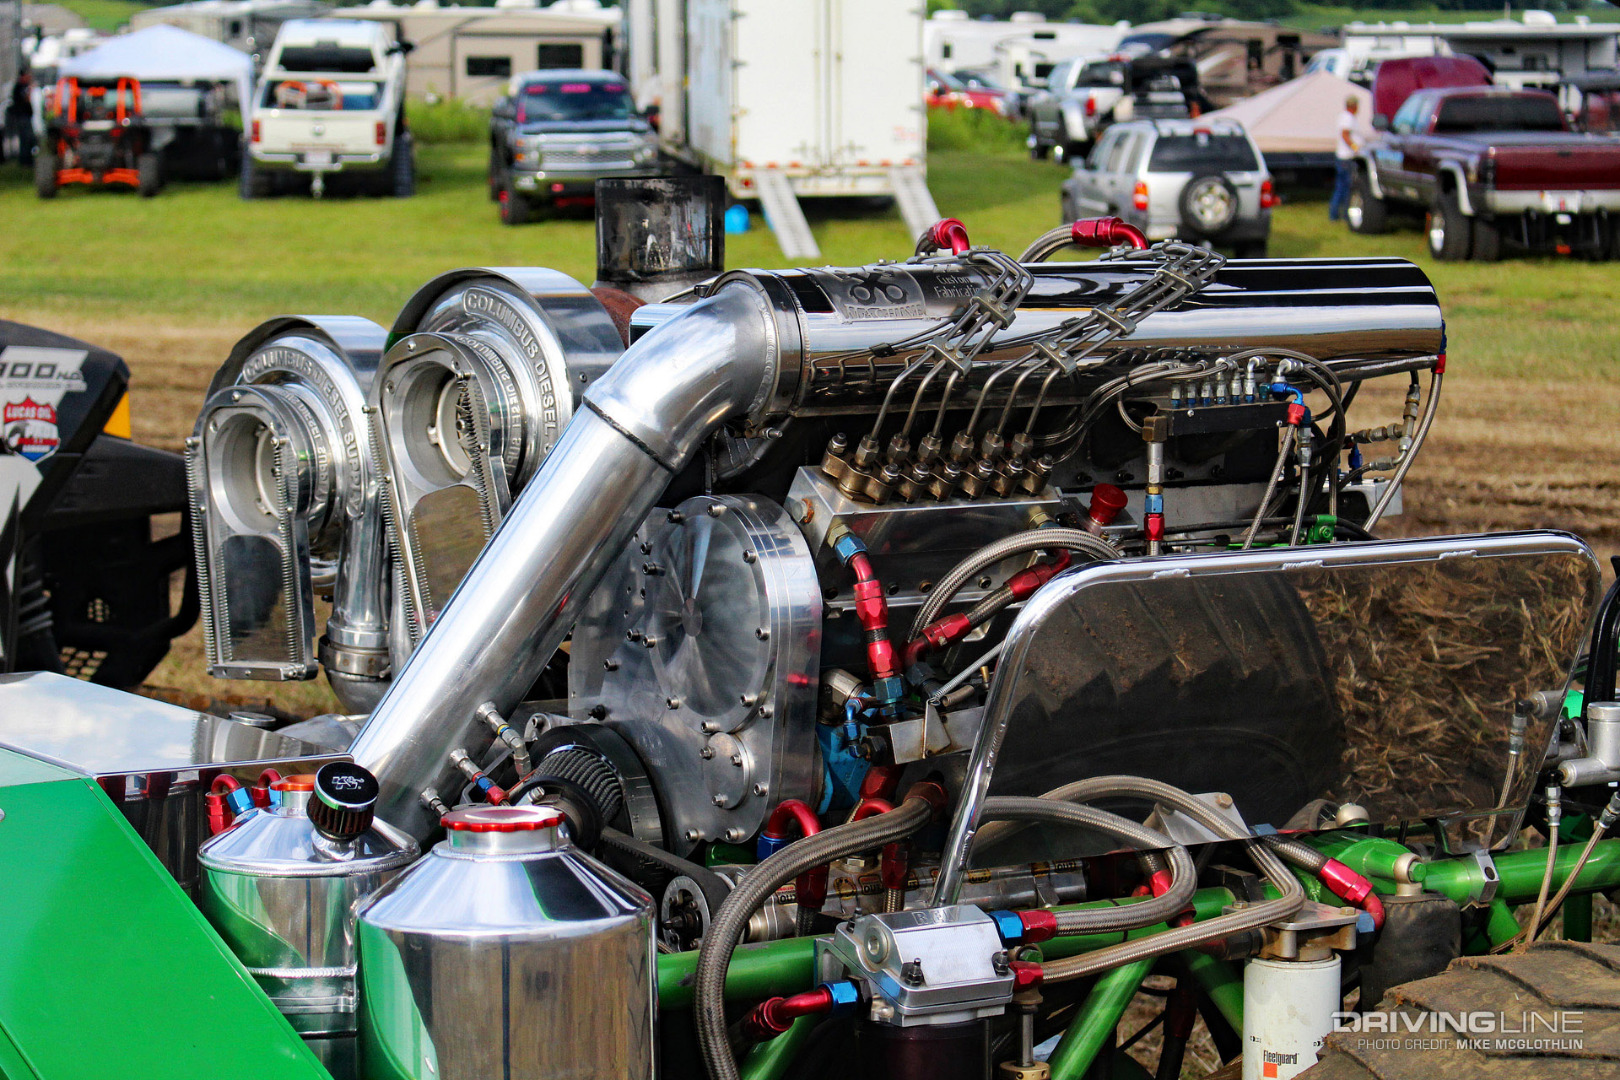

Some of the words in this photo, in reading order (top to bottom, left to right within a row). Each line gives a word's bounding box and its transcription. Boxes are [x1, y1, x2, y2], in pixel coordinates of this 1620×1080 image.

[936, 274, 972, 285] Custom
[467, 293, 539, 359] COLUMBUS
[534, 359, 557, 437] DIESEL
[6, 405, 36, 419] LUCAS
[37, 406, 52, 419] OIL
[244, 350, 313, 379] COLUMBUS
[312, 369, 349, 429] DIESEL
[344, 431, 362, 514] SUPPLY
[1263, 1049, 1298, 1066] Fleetguard
